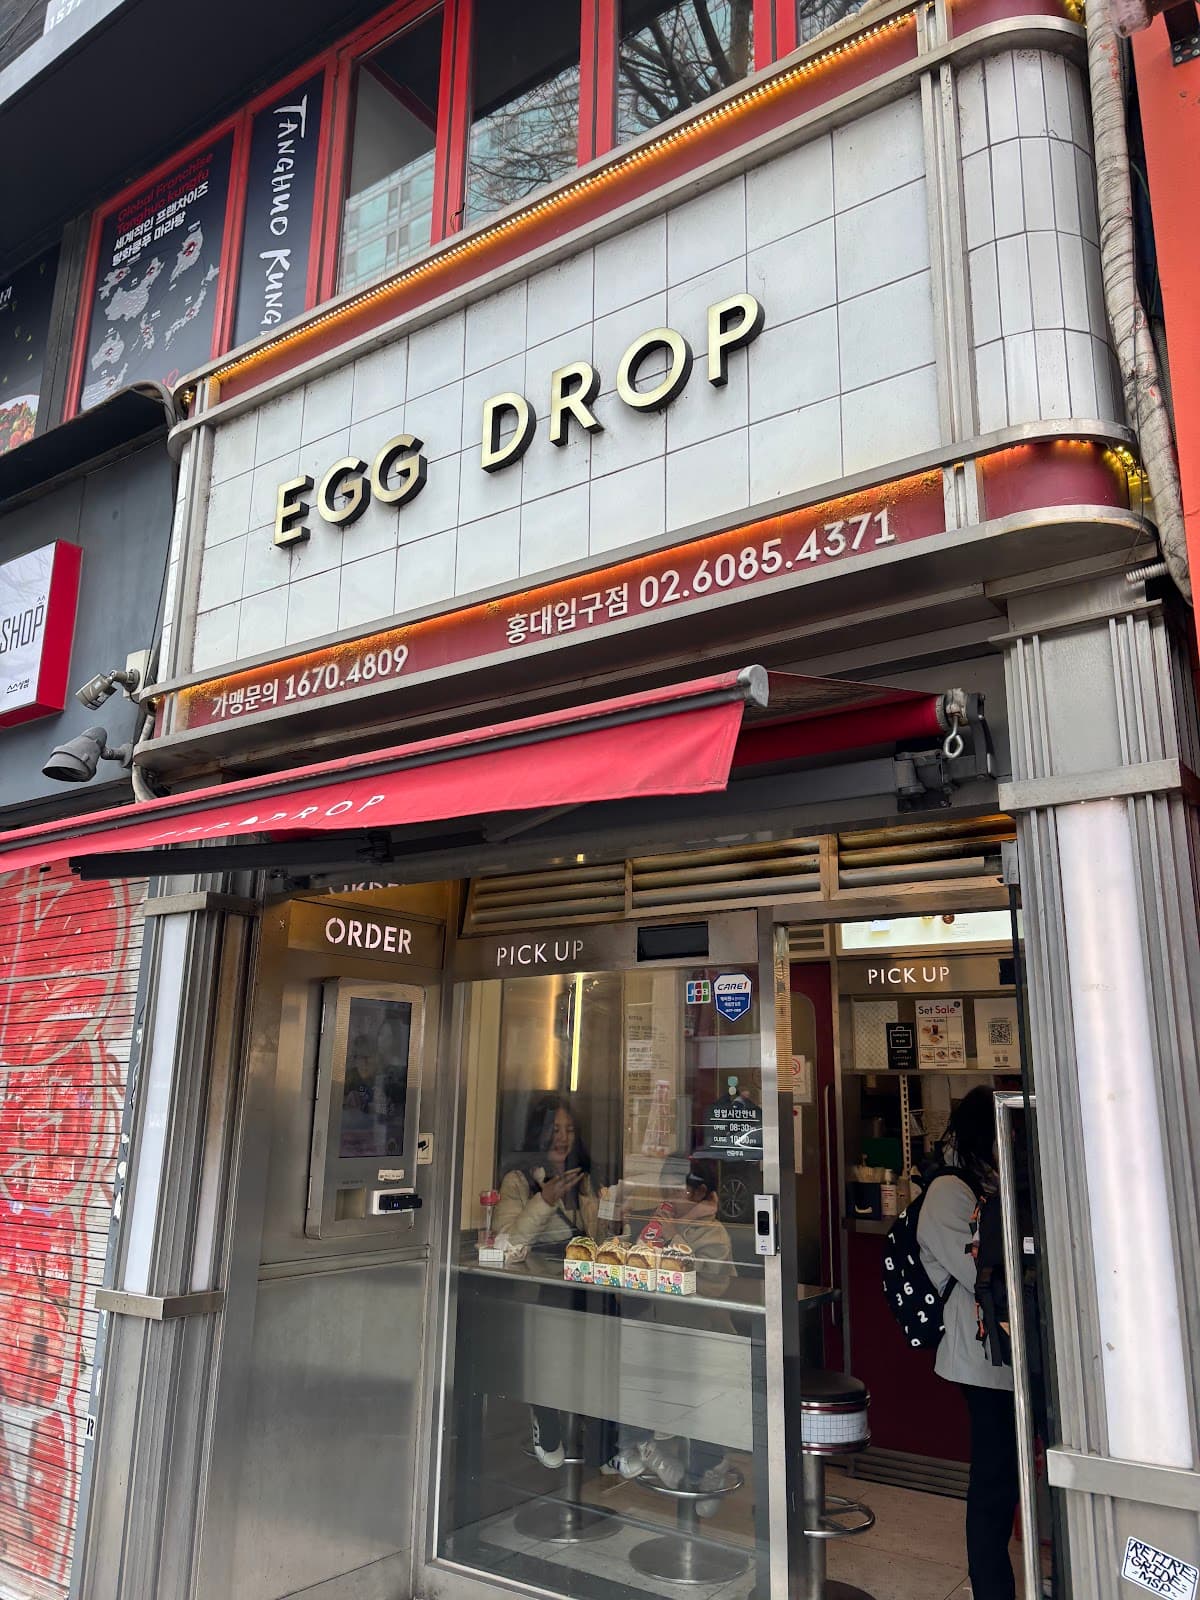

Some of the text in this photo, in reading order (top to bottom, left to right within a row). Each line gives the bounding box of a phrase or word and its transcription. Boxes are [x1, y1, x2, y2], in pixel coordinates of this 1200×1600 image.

[113, 216, 155, 252] 세계적인
[259, 248, 291, 336] KUNG
[273, 293, 765, 549] EGG DROP
[505, 508, 896, 645] 홍대입구점 02.6085.4371
[0, 605, 45, 655] SHOP
[211, 644, 409, 718] 가맹문의 1670.4809
[325, 917, 412, 955] ORDER
[496, 939, 584, 967] PICK UP
[687, 987, 710, 997] JCB
[867, 966, 950, 985] PICK UP
[918, 1005, 956, 1015] Set Sale
[713, 1109, 757, 1119] 영업시간안내
[884, 1256, 895, 1271] 8
[1130, 1541, 1196, 1585] RETIRE
[1138, 1571, 1171, 1593] MSP
